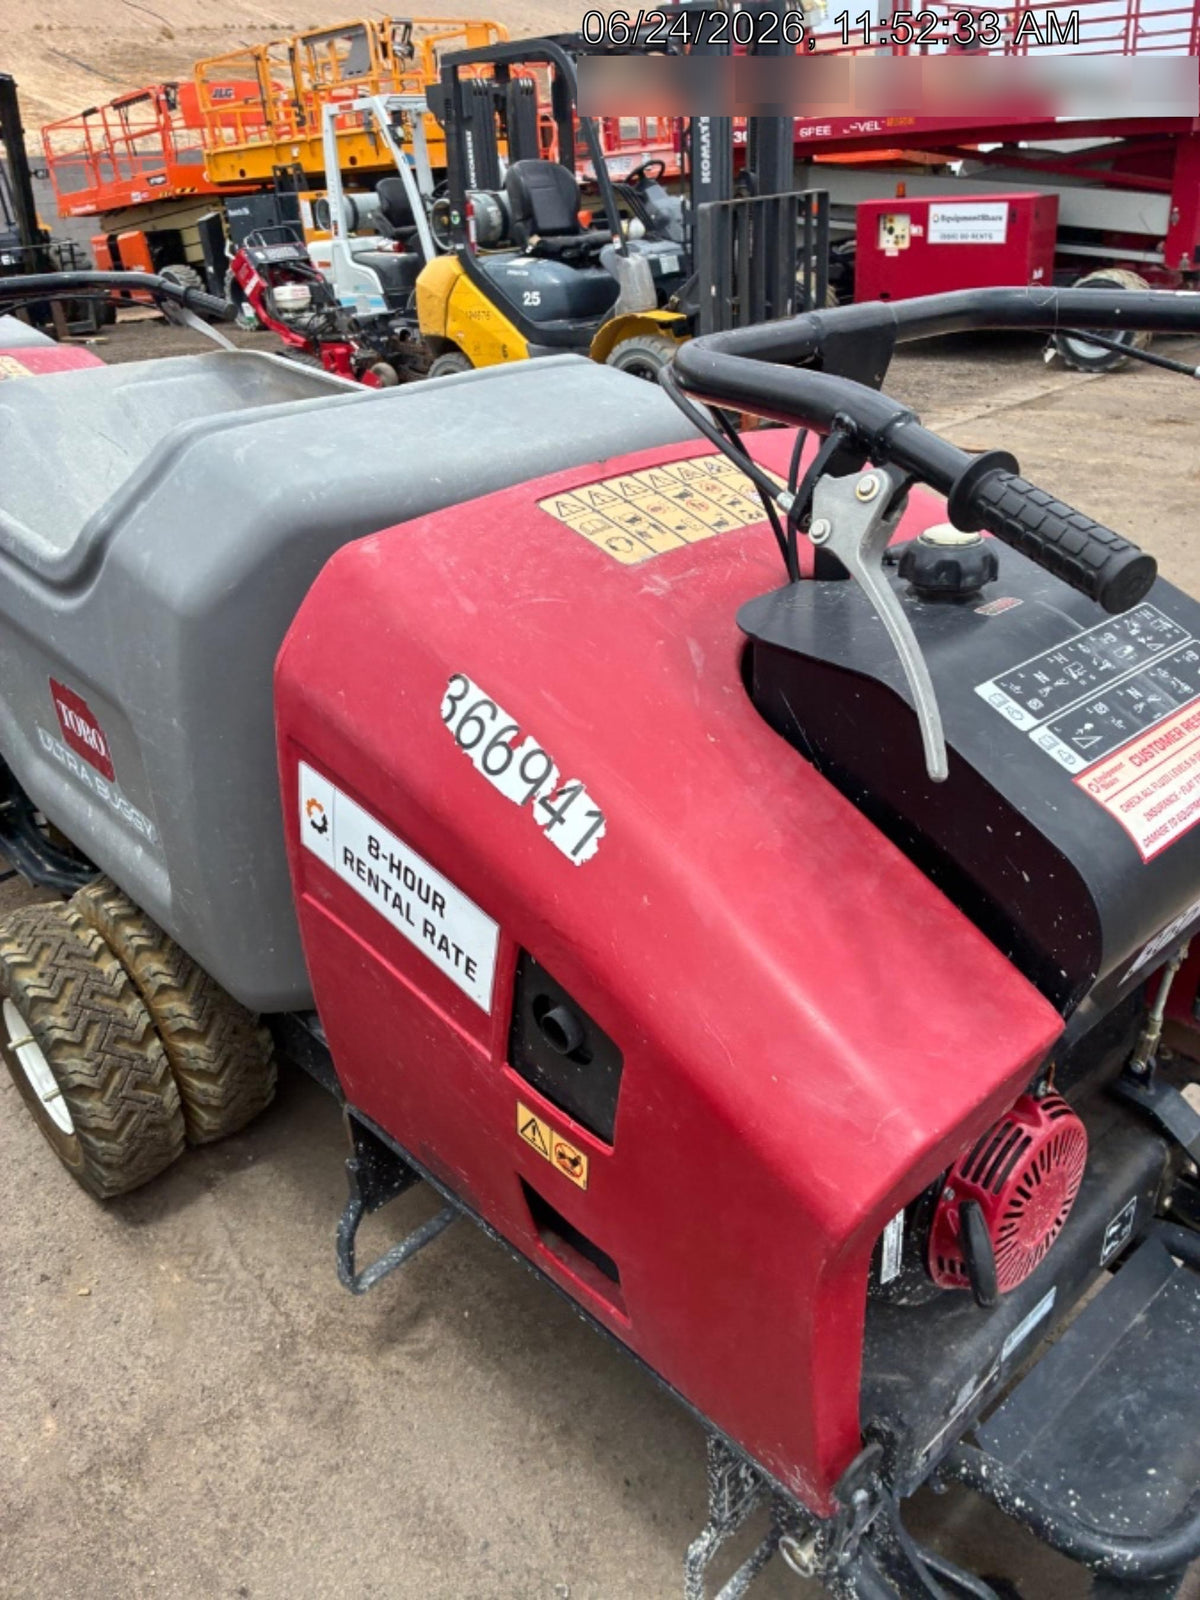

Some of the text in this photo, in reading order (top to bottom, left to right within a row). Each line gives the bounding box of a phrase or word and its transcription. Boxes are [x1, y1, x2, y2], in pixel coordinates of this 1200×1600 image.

[212, 88, 234, 98] JLG
[698, 117, 711, 184] KOMATS
[523, 291, 541, 306] 25
[56, 699, 107, 757] TORO
[1129, 727, 1186, 767] CUSTOMER
[441, 673, 605, 857] 366941
[368, 834, 446, 919] 8-HOUR
[343, 846, 478, 982] RENTAL RATE
